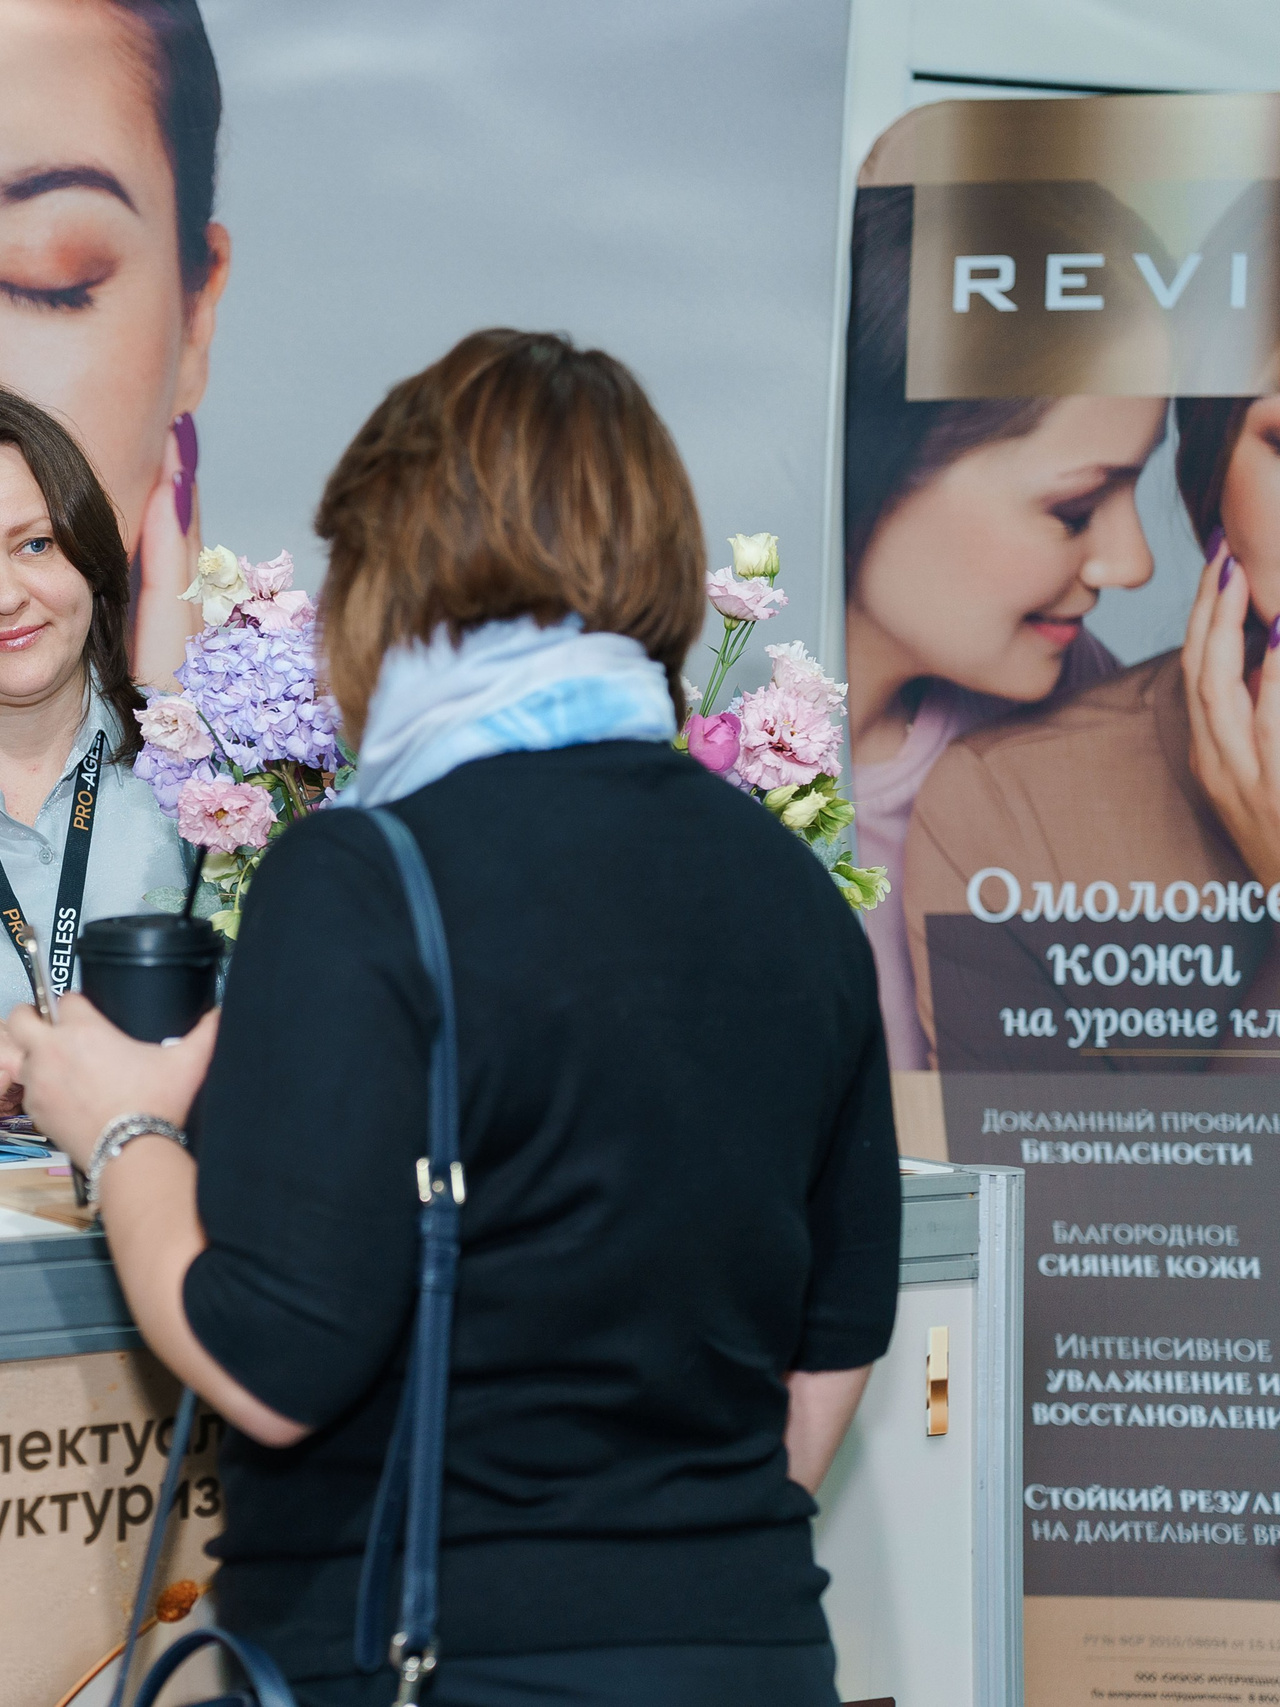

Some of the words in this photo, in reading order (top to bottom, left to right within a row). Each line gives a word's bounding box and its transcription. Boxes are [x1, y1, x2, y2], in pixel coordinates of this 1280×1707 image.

[953, 253, 1248, 313] REVI
[73, 733, 102, 831] PRO-AGE
[51, 907, 77, 997] AGELESS
[1046, 943, 1242, 987] кожи
[998, 1007, 1058, 1038] на
[1065, 1007, 1218, 1049] уровне
[981, 1107, 1156, 1135] ДОКАЗАННЫЙ
[1020, 1137, 1253, 1166] БЕЗОПАСНОСТИ
[1052, 1219, 1240, 1248] БЛАГОРОДНОЕ
[1037, 1253, 1159, 1278] СИЯНИЕ
[1165, 1256, 1261, 1280] КОЖИ
[1054, 1332, 1274, 1364] ИНТЕНСИВНОЕ
[1046, 1369, 1253, 1396] УВЛАЖНЕНИЕ
[1024, 1483, 1174, 1513] СТОЙКИЙ
[1031, 1520, 1068, 1544] НА
[1075, 1520, 1248, 1546] ДЛИТЕЛЬНОЕ
